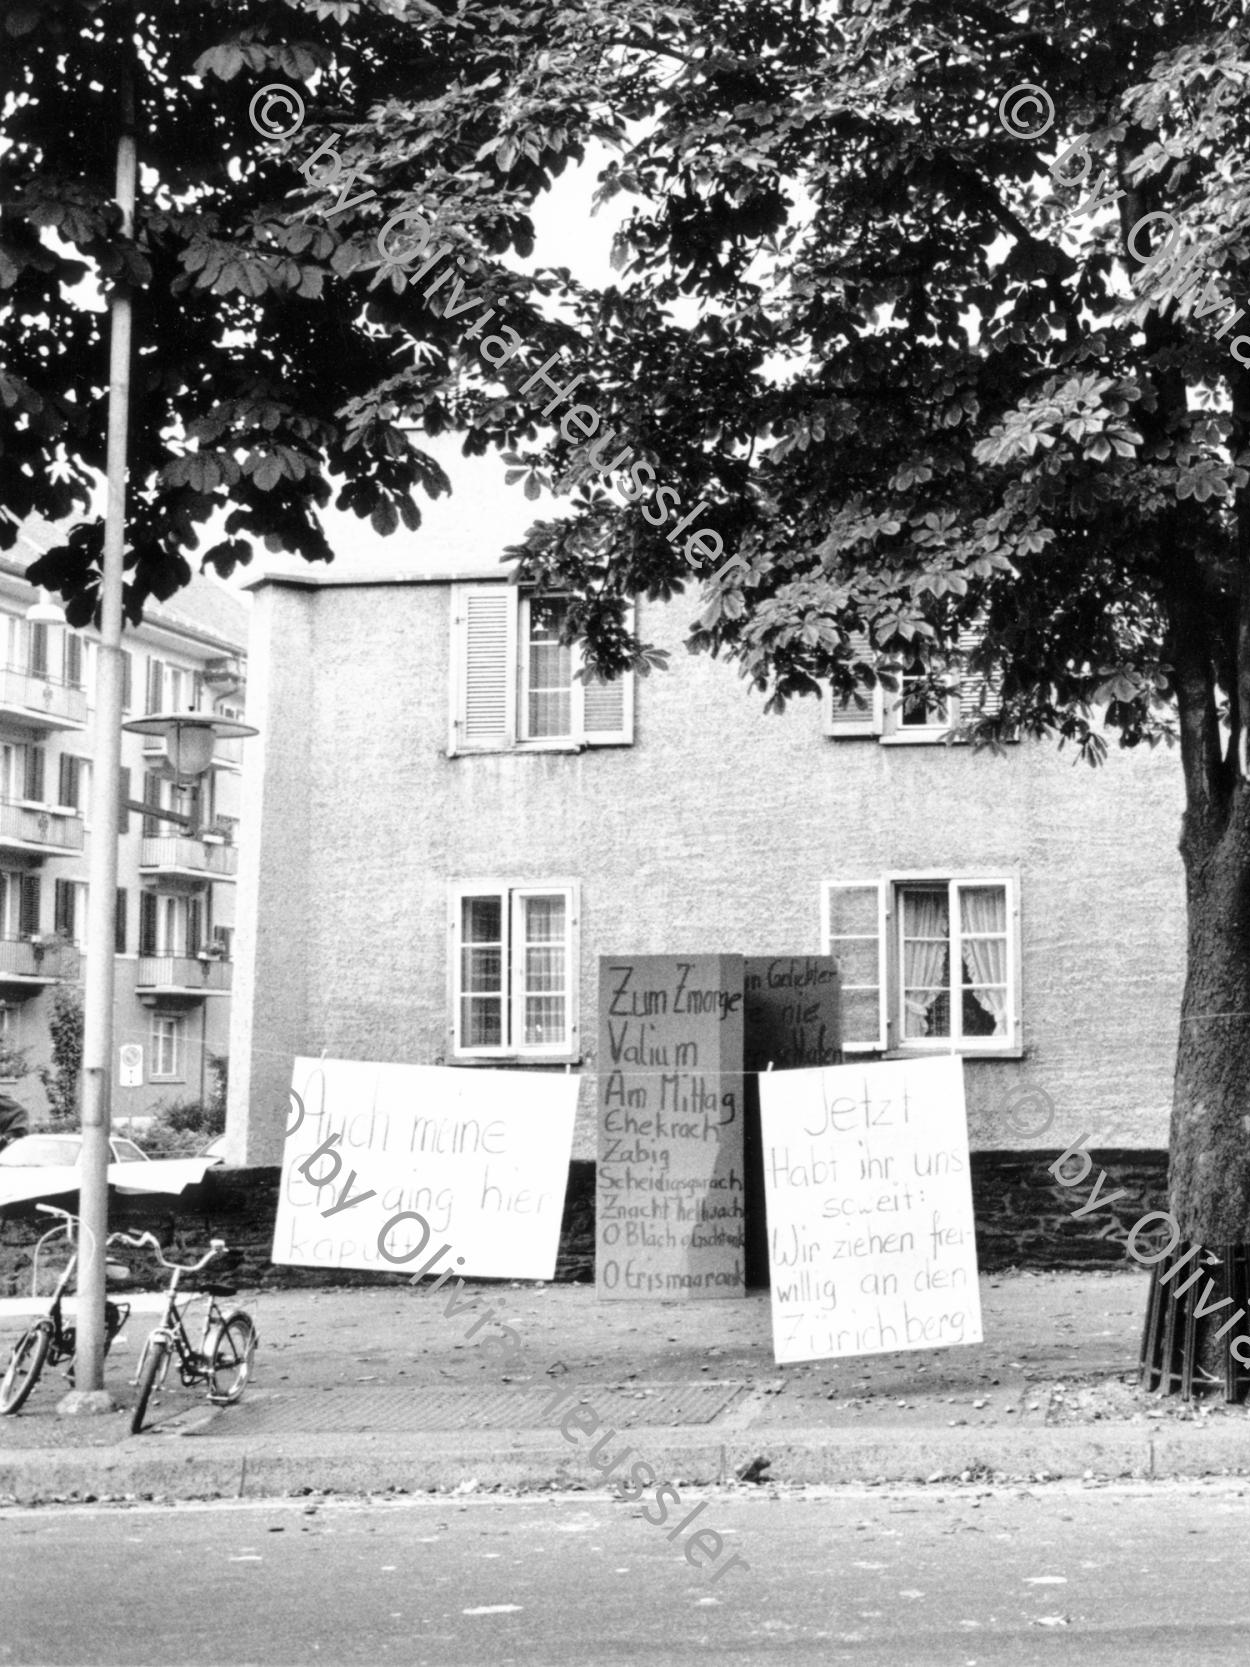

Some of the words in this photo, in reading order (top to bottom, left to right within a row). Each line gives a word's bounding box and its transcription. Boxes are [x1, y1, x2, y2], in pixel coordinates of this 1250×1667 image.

[609, 966, 667, 1017] Zum
[673, 963, 742, 1021] Zmorge
[607, 1019, 698, 1067] Valium
[301, 1067, 390, 1152] Auch
[410, 1089, 508, 1154] meine
[604, 1108, 720, 1142] Ehekrach
[605, 1070, 647, 1108] Am
[660, 1071, 736, 1126] Mittag
[803, 1070, 913, 1136] Jetzt
[602, 1137, 670, 1170] Zabig
[766, 1145, 840, 1189] Habt
[859, 1134, 895, 1180] ihr
[914, 1148, 964, 1178] uns
[286, 1153, 363, 1209] Ehe
[382, 1166, 454, 1232] ging
[480, 1163, 552, 1214] hier
[600, 1193, 671, 1220] Znacht
[772, 1223, 820, 1267] Wir
[831, 1218, 915, 1260] ziehen
[775, 1268, 838, 1312] willig
[860, 1271, 898, 1296] an
[914, 1256, 967, 1292] den
